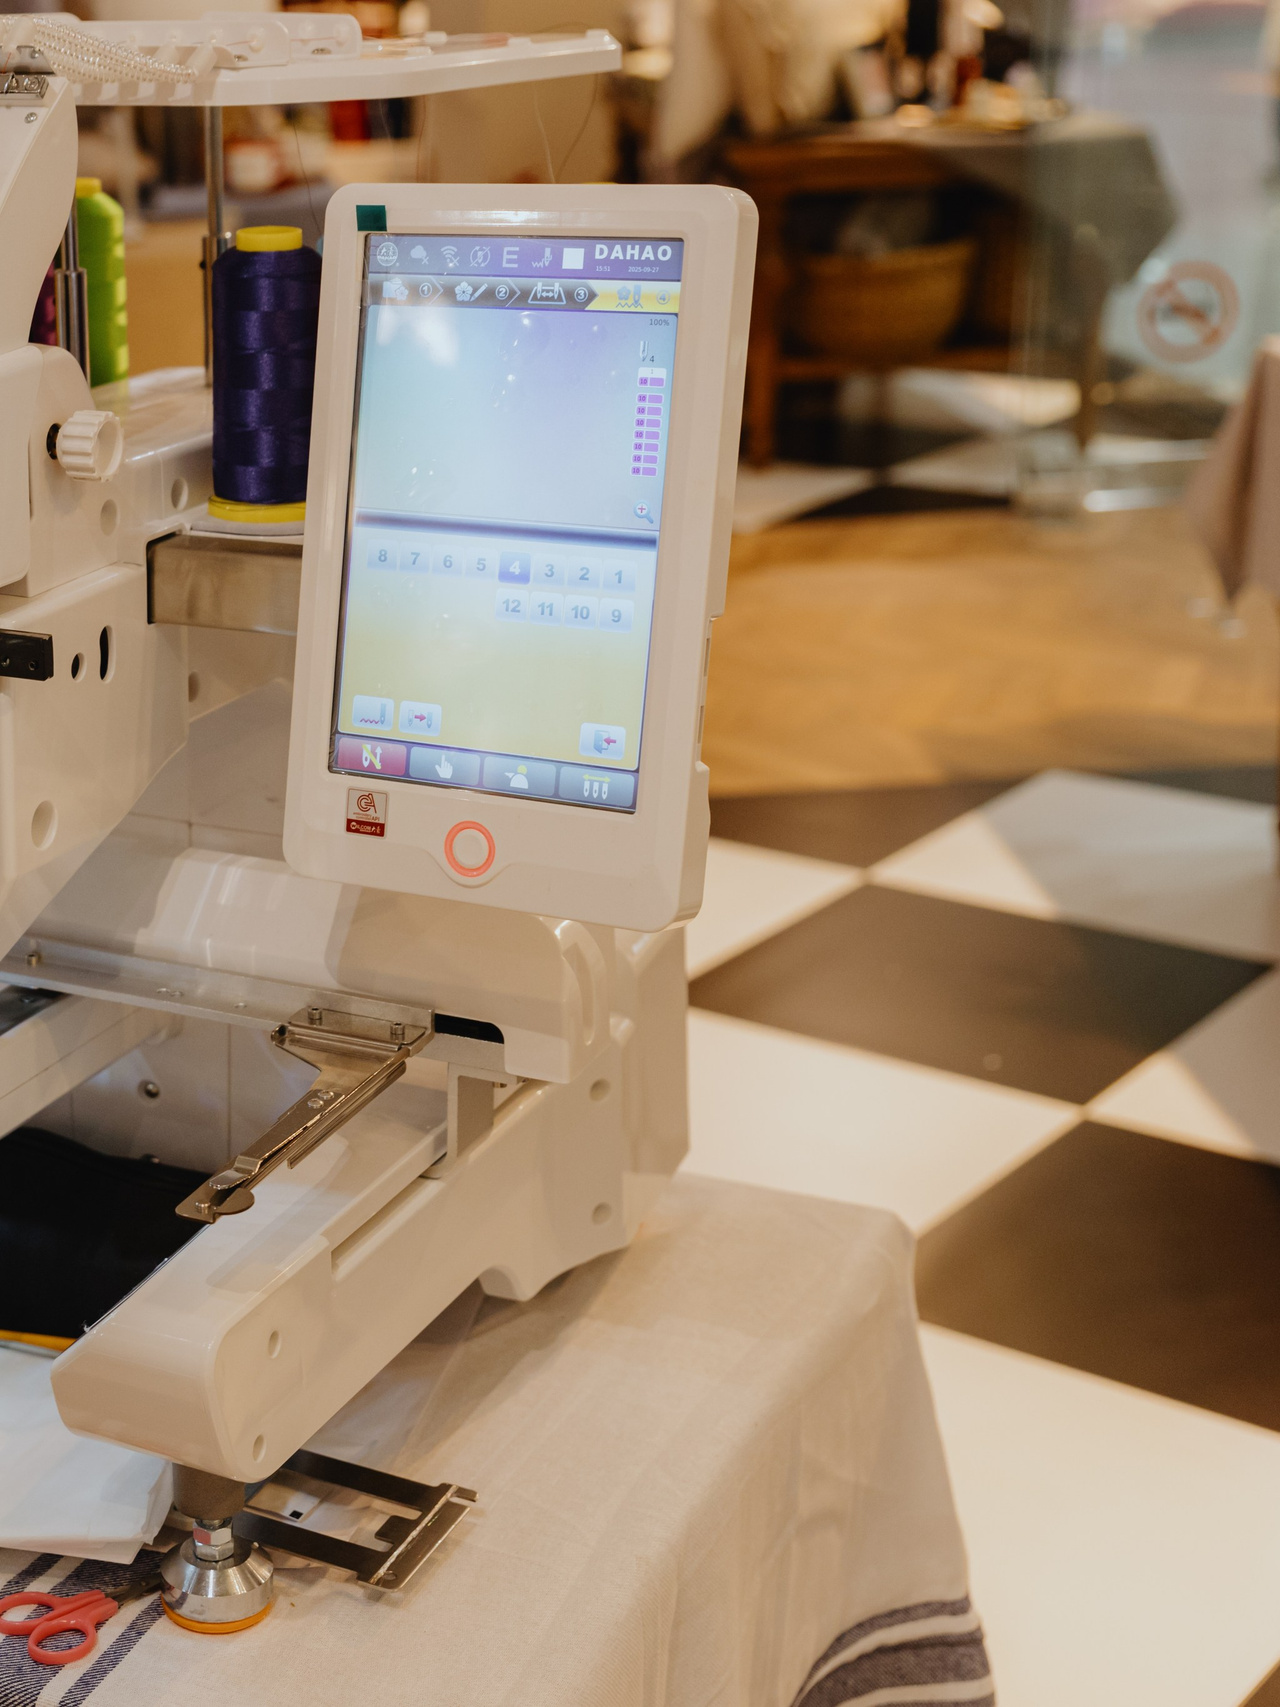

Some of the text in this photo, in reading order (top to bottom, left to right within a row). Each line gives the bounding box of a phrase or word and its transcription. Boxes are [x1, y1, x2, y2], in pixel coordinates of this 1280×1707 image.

[502, 247, 520, 268] E
[594, 244, 672, 261] DAHAO
[378, 549, 623, 584] 8 7 6 5 4 3 2 1
[502, 599, 621, 623] 12 11 10 9
